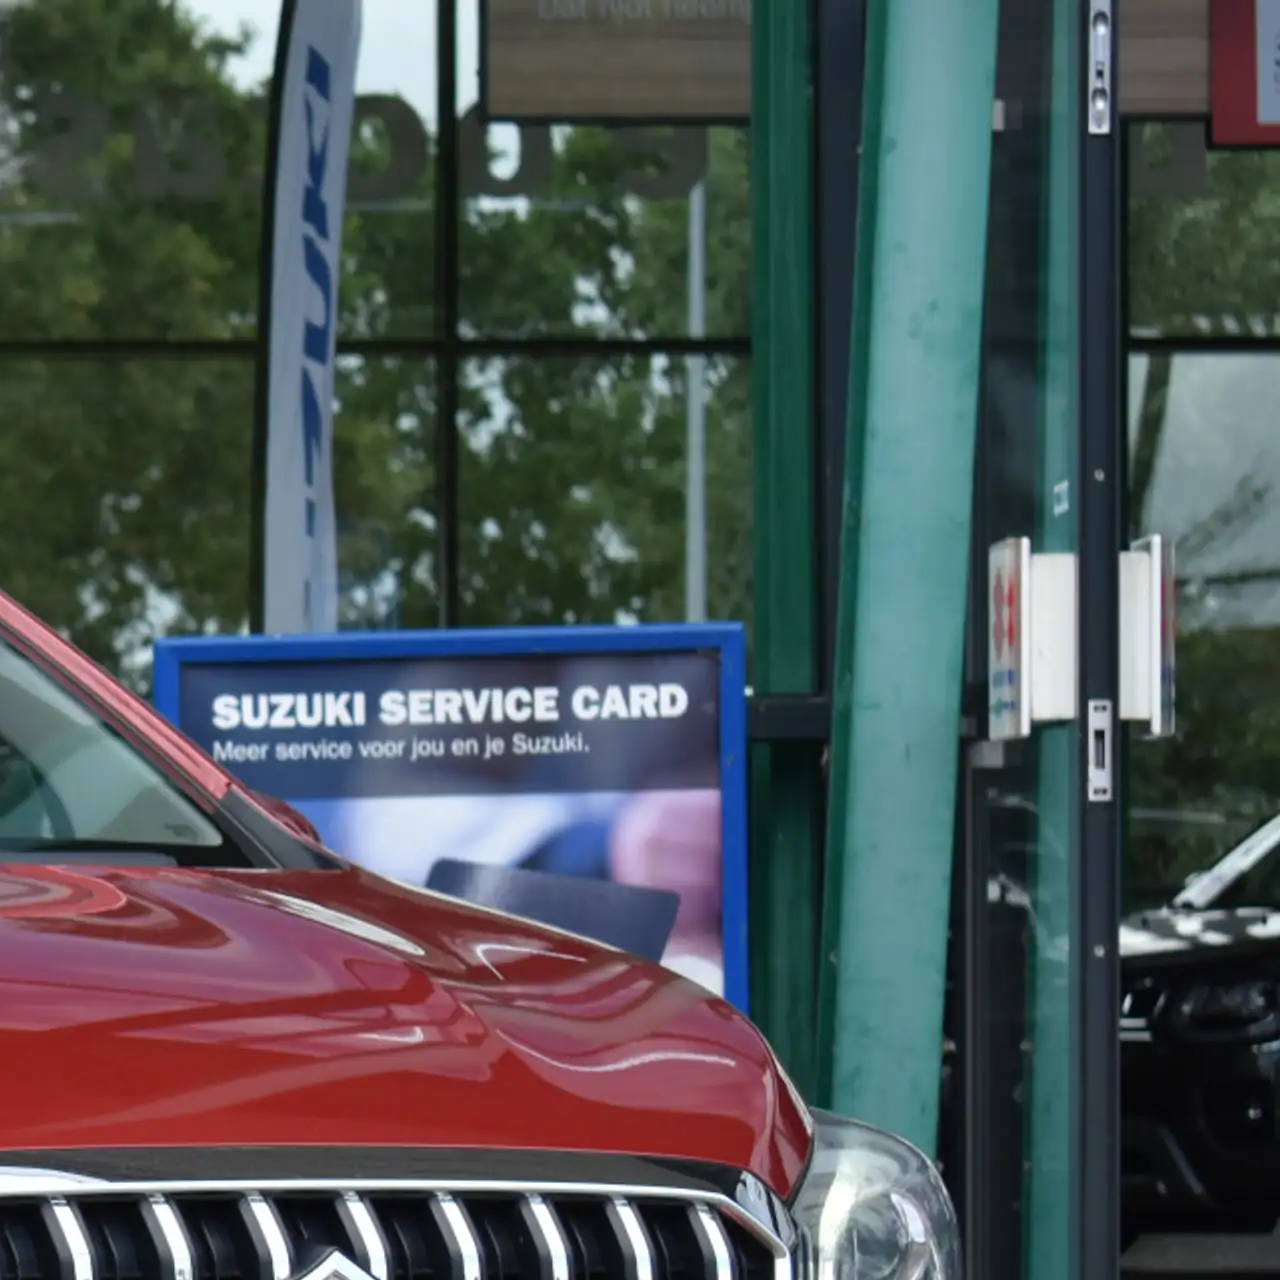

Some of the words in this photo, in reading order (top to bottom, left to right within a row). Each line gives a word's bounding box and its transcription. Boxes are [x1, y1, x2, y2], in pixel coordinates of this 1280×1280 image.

[211, 691, 367, 730] SUZUKI
[378, 686, 560, 726] SERVICE
[571, 682, 689, 720] CARD
[212, 740, 270, 762] Meer
[275, 738, 353, 761] service
[357, 740, 407, 758] voor
[410, 735, 446, 761] jou
[451, 738, 480, 756] en
[483, 734, 506, 760] je
[512, 731, 591, 755] Suzuki.
